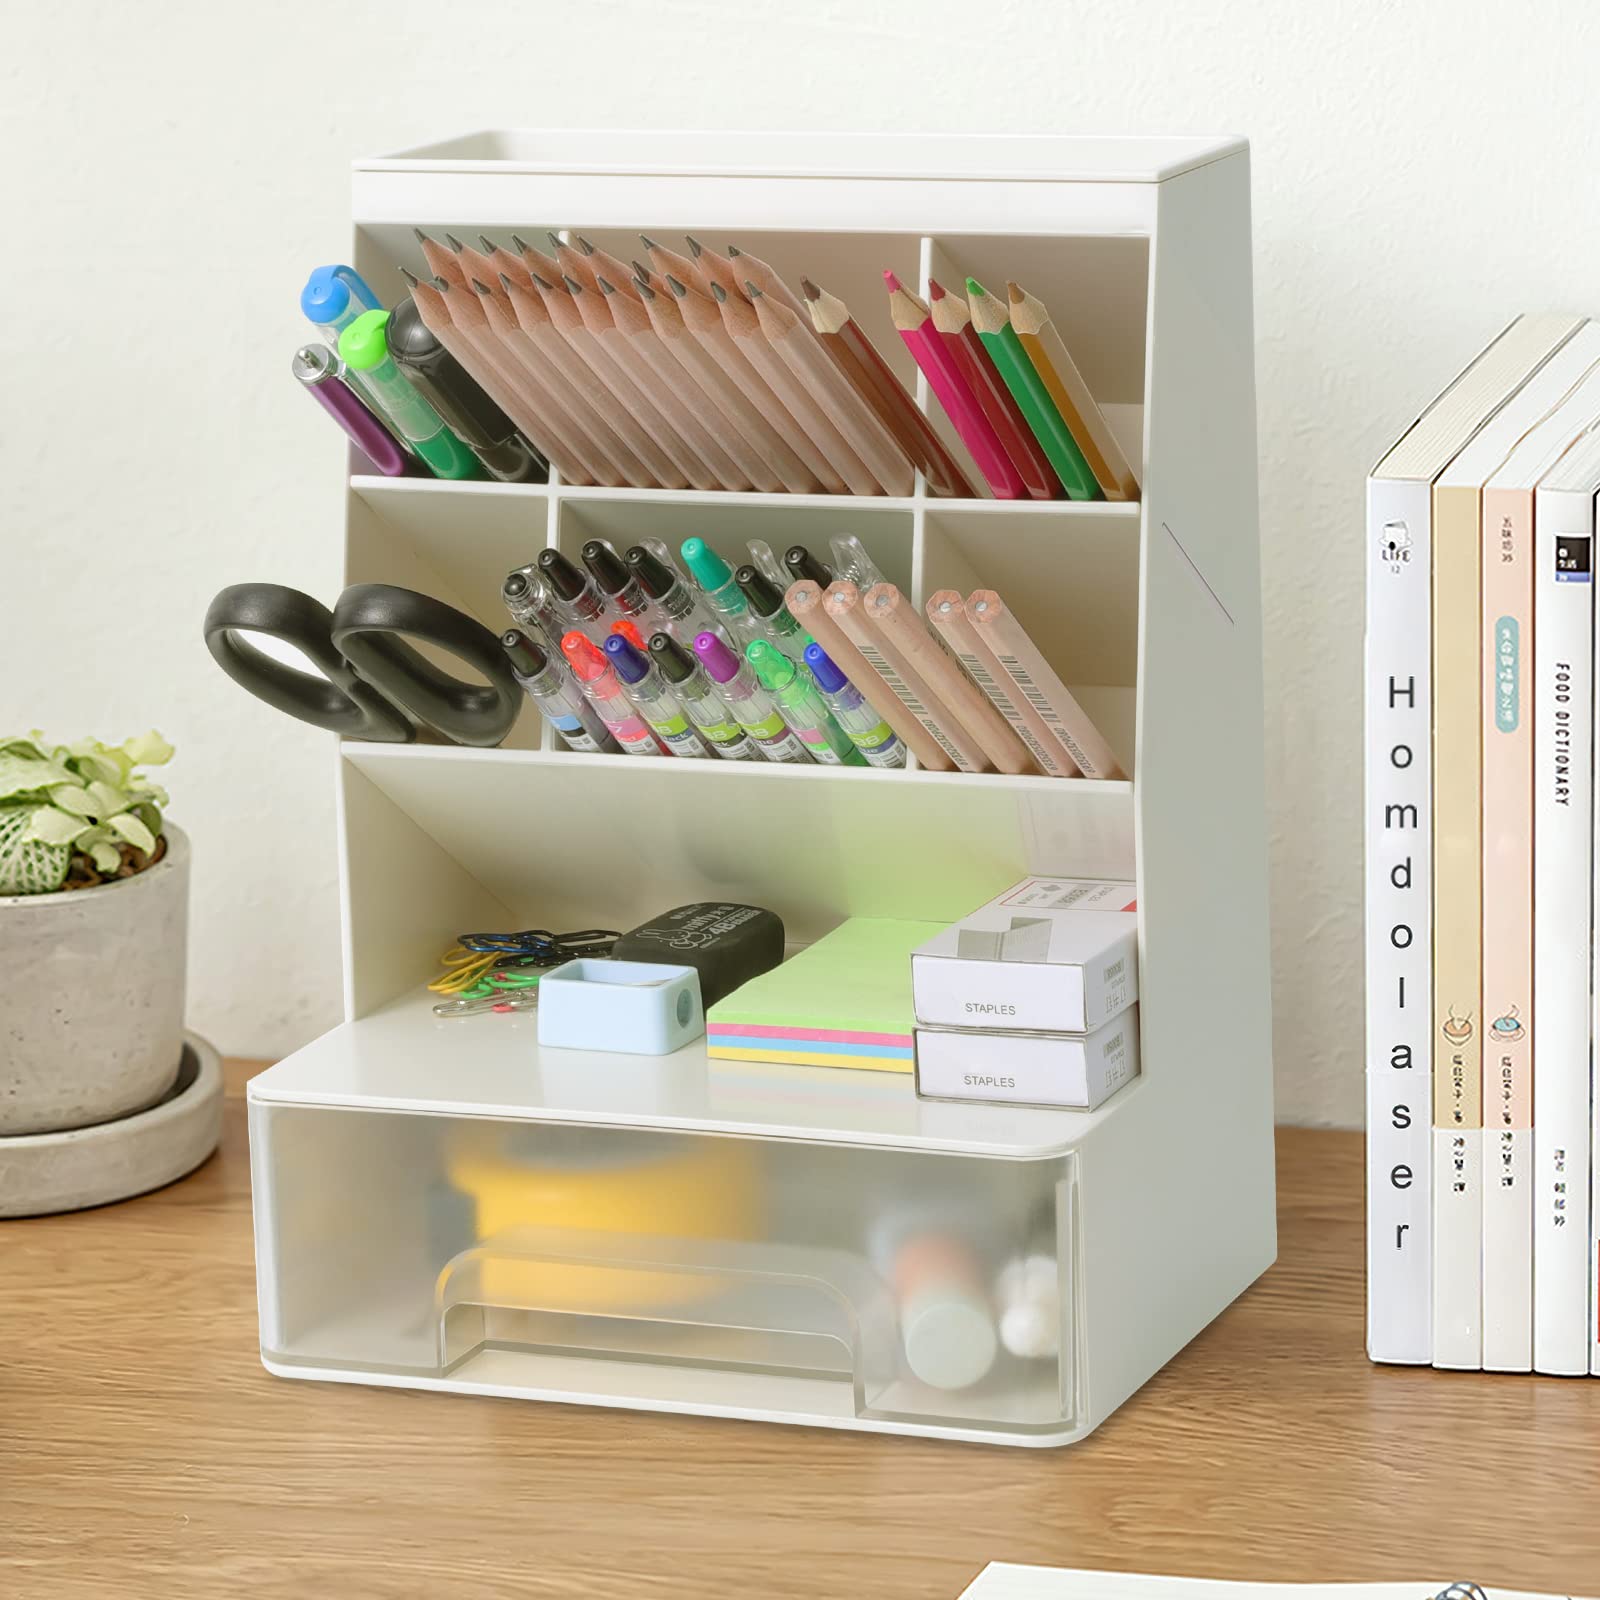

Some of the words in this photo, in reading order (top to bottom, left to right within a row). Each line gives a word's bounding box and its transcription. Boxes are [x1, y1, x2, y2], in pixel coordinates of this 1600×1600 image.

[1381, 549, 1411, 562] LIFE
[1555, 662, 1571, 703] FOOD
[1555, 711, 1571, 806] DICTIONARY
[1385, 675, 1419, 1251] Homdolaser
[965, 1002, 1017, 1016] STAPLES
[963, 1075, 1016, 1089] STAPLES
